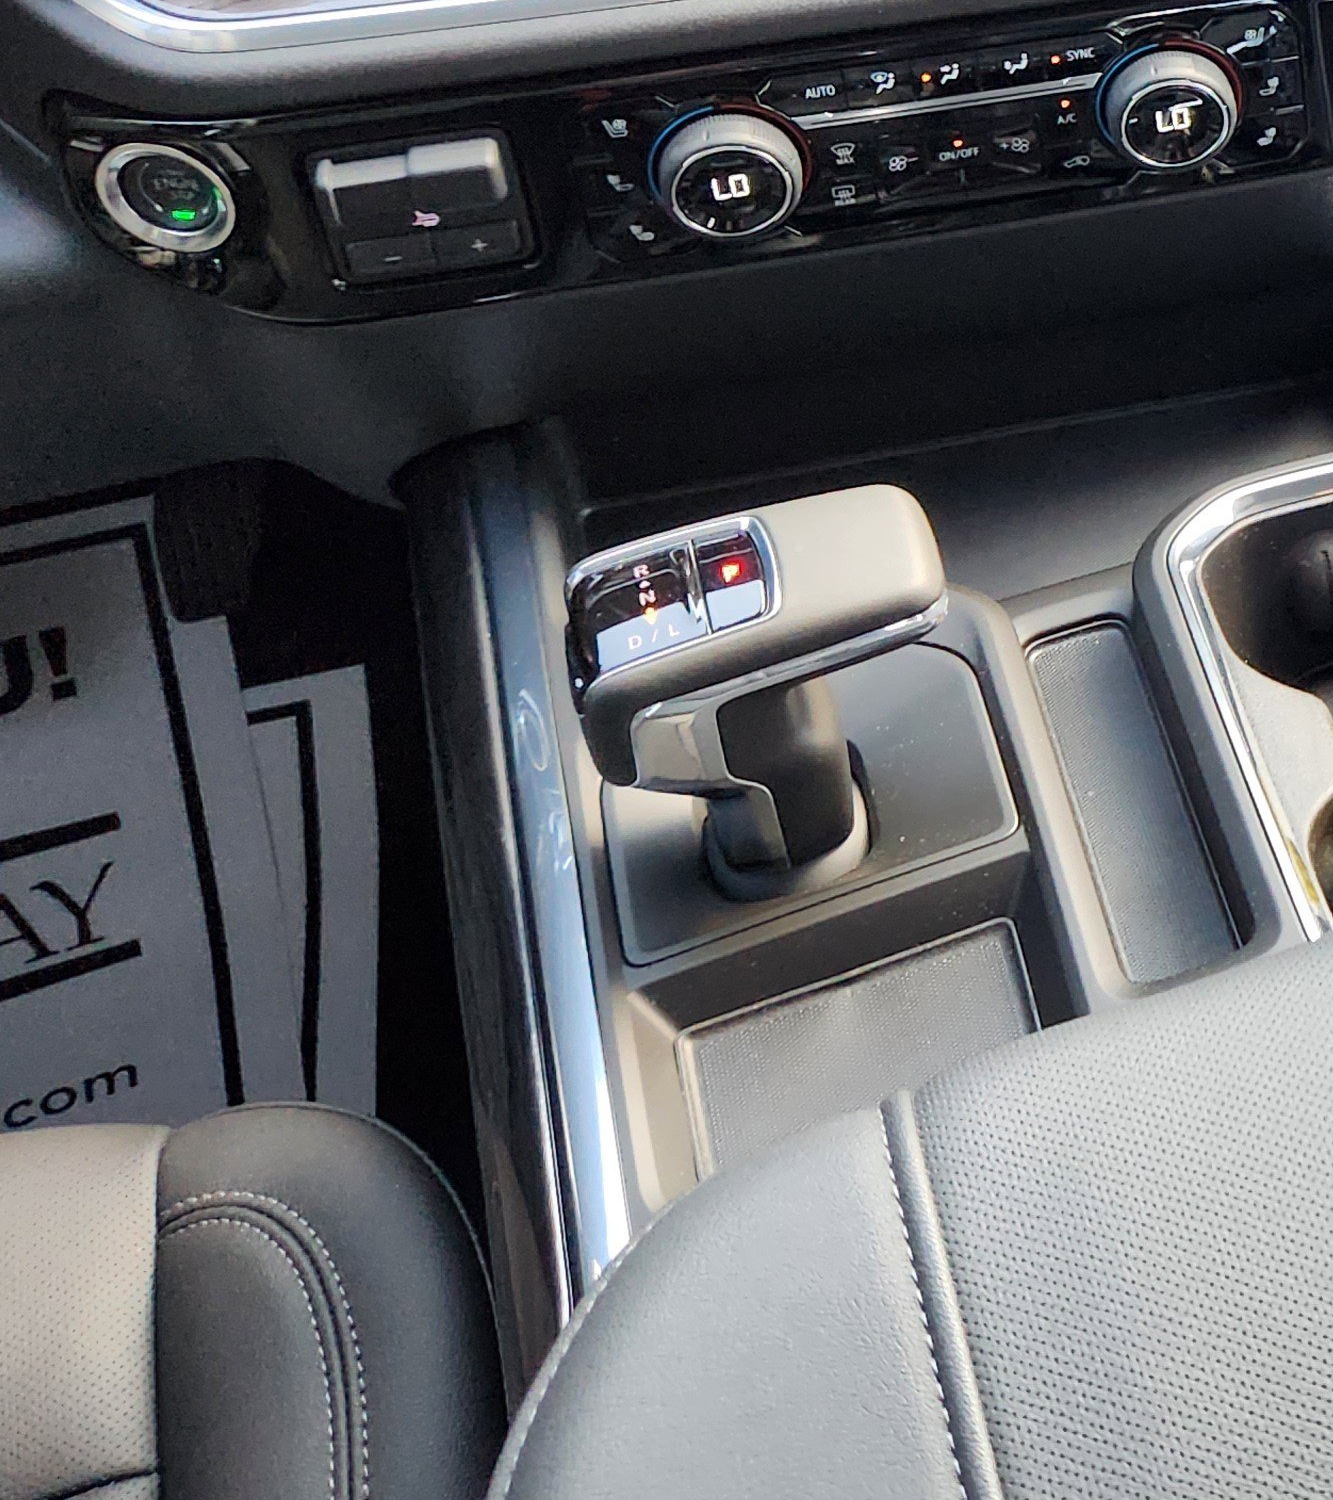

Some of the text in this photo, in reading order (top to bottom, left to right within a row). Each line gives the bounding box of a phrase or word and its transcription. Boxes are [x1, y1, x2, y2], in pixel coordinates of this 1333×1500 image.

[1065, 46, 1096, 62] SYNC
[804, 83, 836, 99] AUTO
[1056, 112, 1077, 125] A/C
[938, 146, 980, 162] ON/OFF
[632, 563, 651, 579] R
[638, 588, 657, 607] N
[627, 634, 643, 651] D
